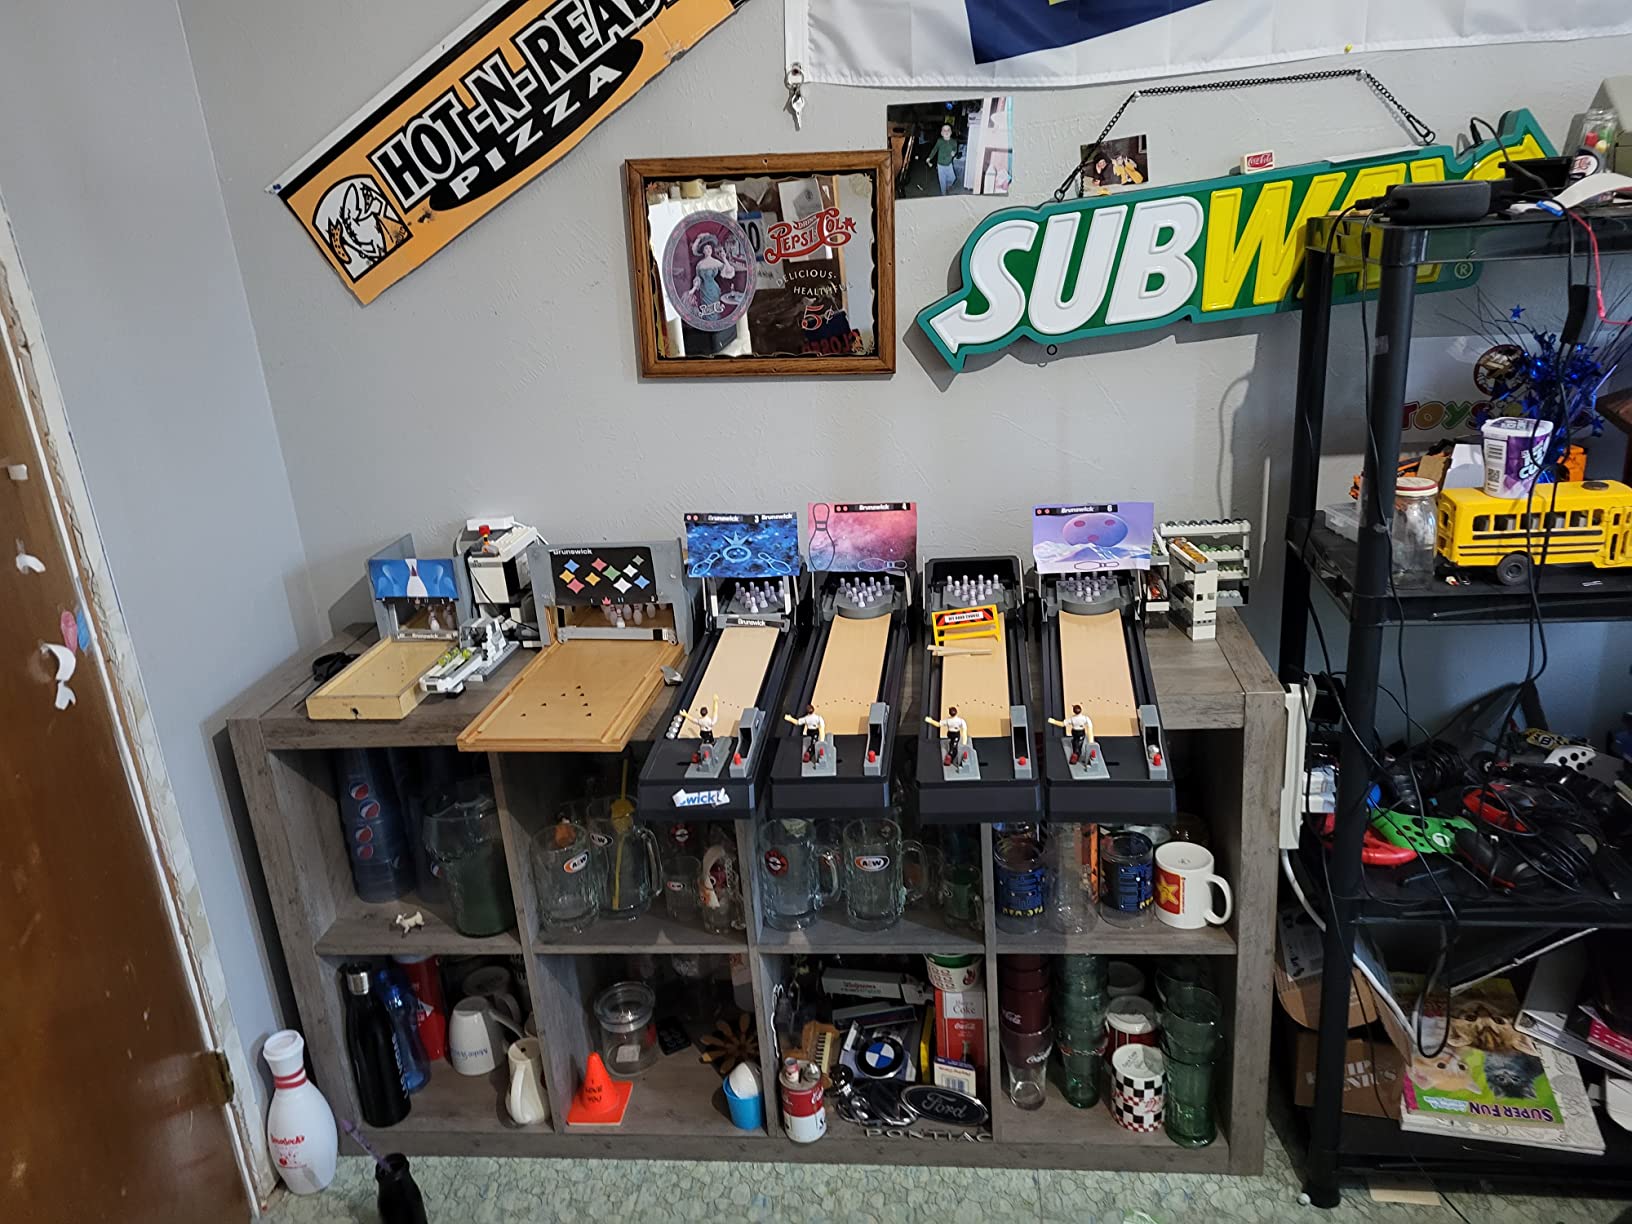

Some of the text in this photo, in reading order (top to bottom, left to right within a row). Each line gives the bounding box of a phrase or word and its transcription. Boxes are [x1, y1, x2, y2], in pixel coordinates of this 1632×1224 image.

[449, 65, 623, 199] PIZZA
[858, 503, 891, 511] Brunswick
[1060, 506, 1096, 514] Brunswick
[737, 618, 766, 627] Brunswick
[953, 1006, 976, 1015] Coke
[921, 1091, 968, 1119] Ford
[1469, 1101, 1502, 1117] FUN
[1503, 1106, 1554, 1123] SUPER
[864, 1127, 993, 1143] PONTIAC
